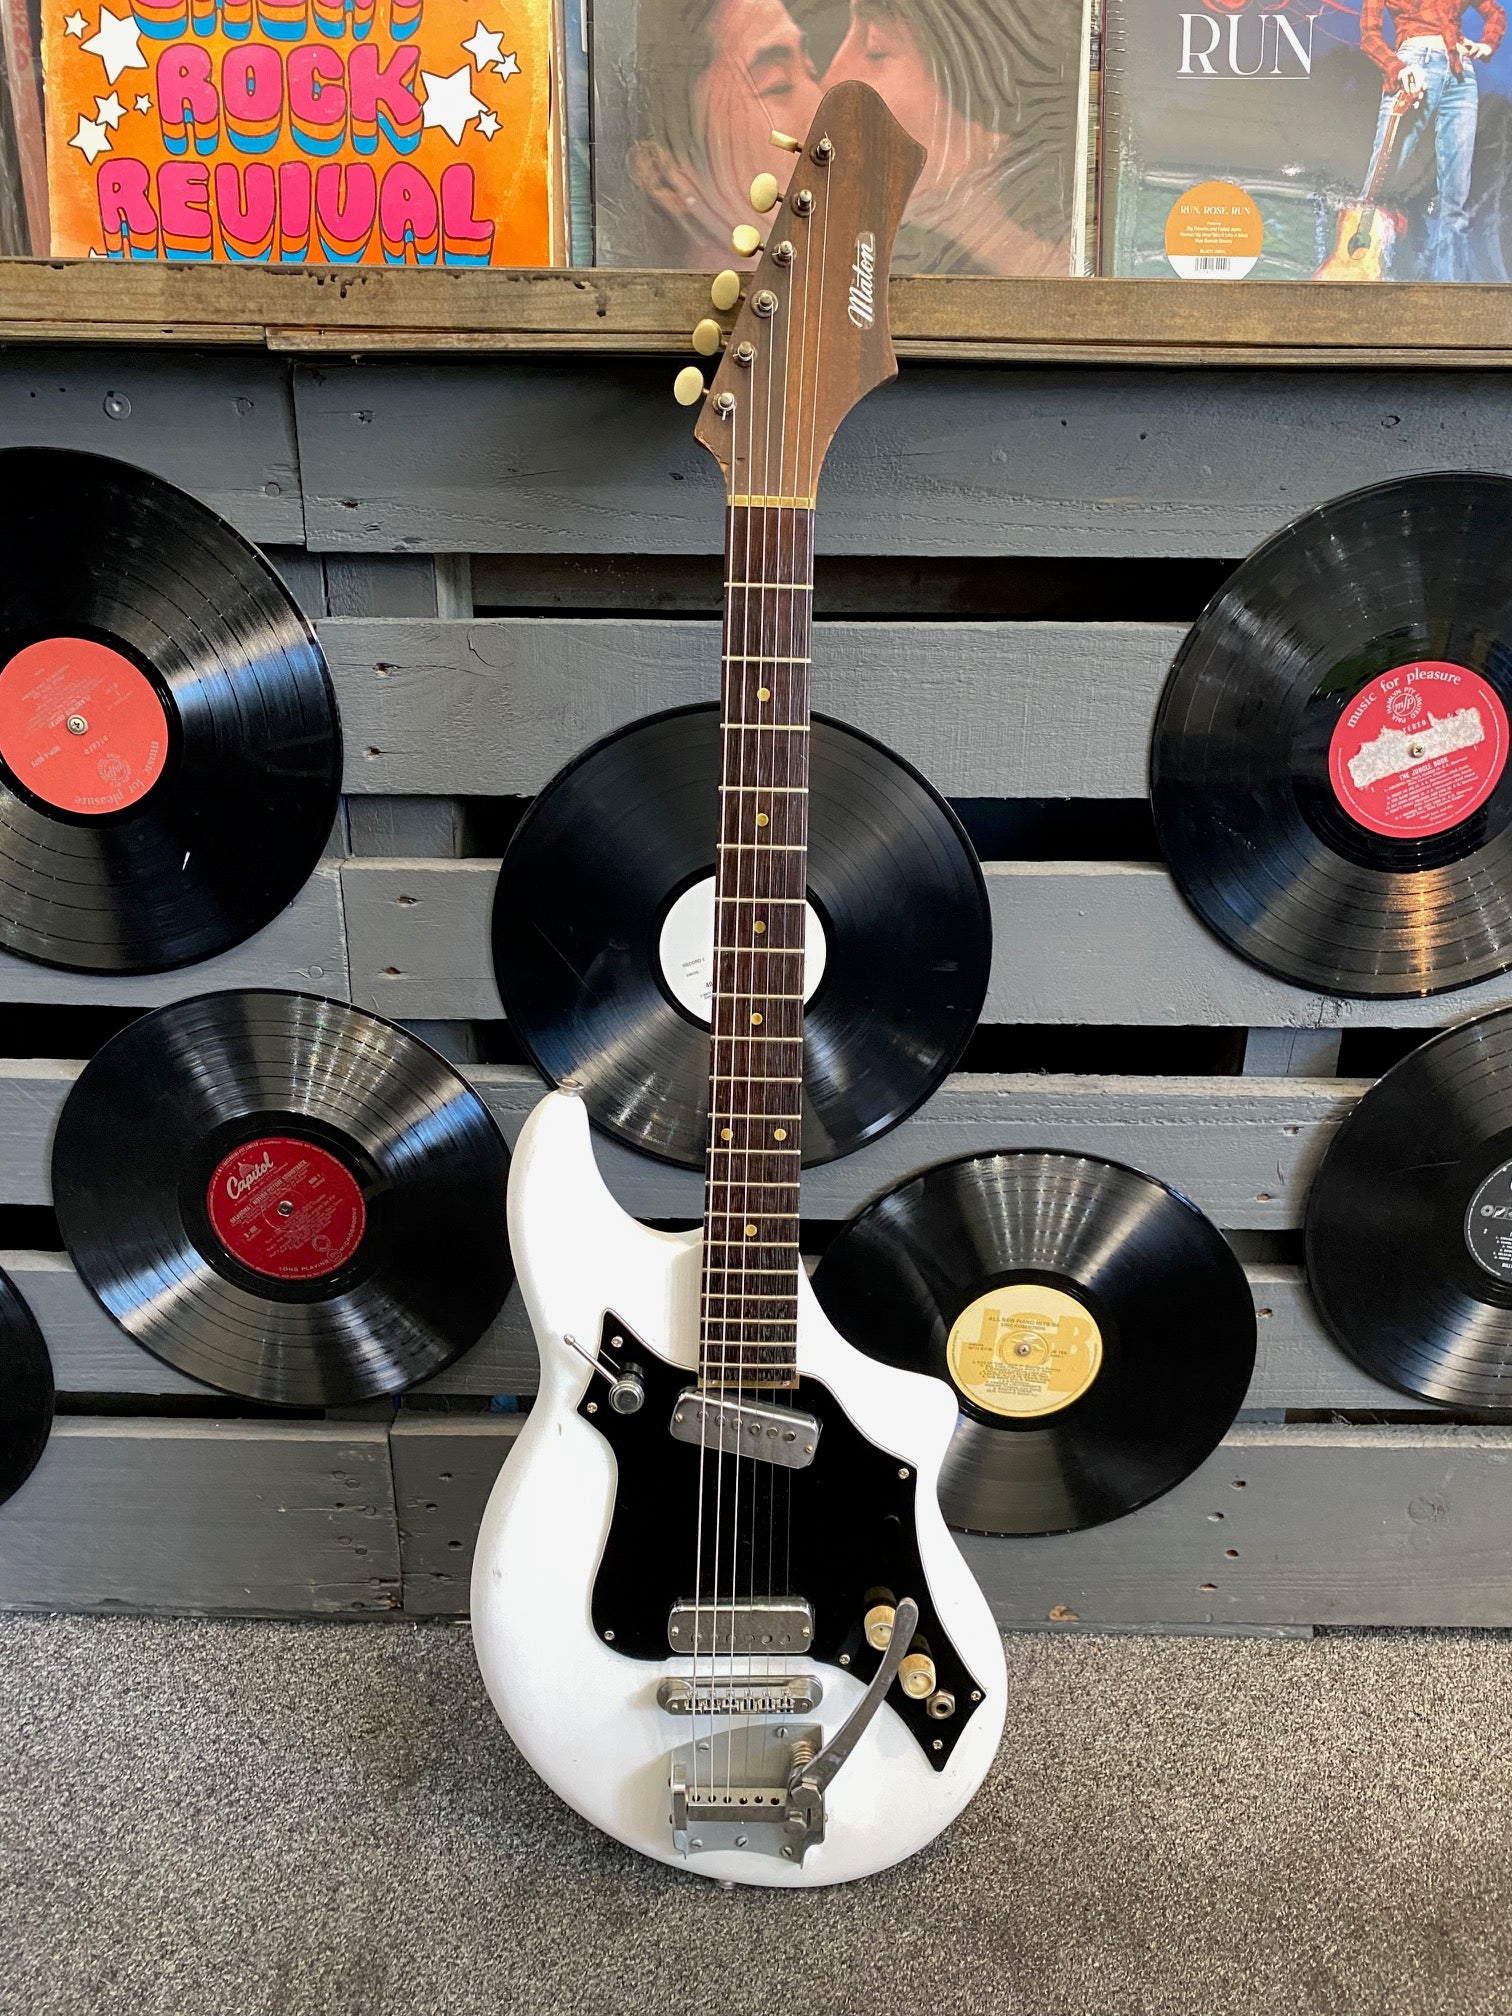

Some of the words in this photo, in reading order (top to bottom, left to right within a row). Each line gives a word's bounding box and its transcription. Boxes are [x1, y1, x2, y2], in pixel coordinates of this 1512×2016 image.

[1176, 13, 1319, 76] RUN
[155, 43, 424, 156] ROCK
[97, 159, 496, 265] REVIVAL
[1231, 206, 1251, 215] RUN
[847, 233, 875, 328] Maton
[1347, 692, 1377, 728] music
[1380, 677, 1400, 692] for
[1406, 667, 1462, 685] pleasure
[128, 777, 146, 793] for
[143, 740, 159, 775] music
[1411, 763, 1432, 776] JUNGLE
[1433, 756, 1449, 767] BOOK
[74, 788, 125, 805] pleasure
[226, 1151, 274, 1200] Capitol
[301, 1259, 330, 1271] PLAYING
[339, 1207, 357, 1251] MICROGROOVE
